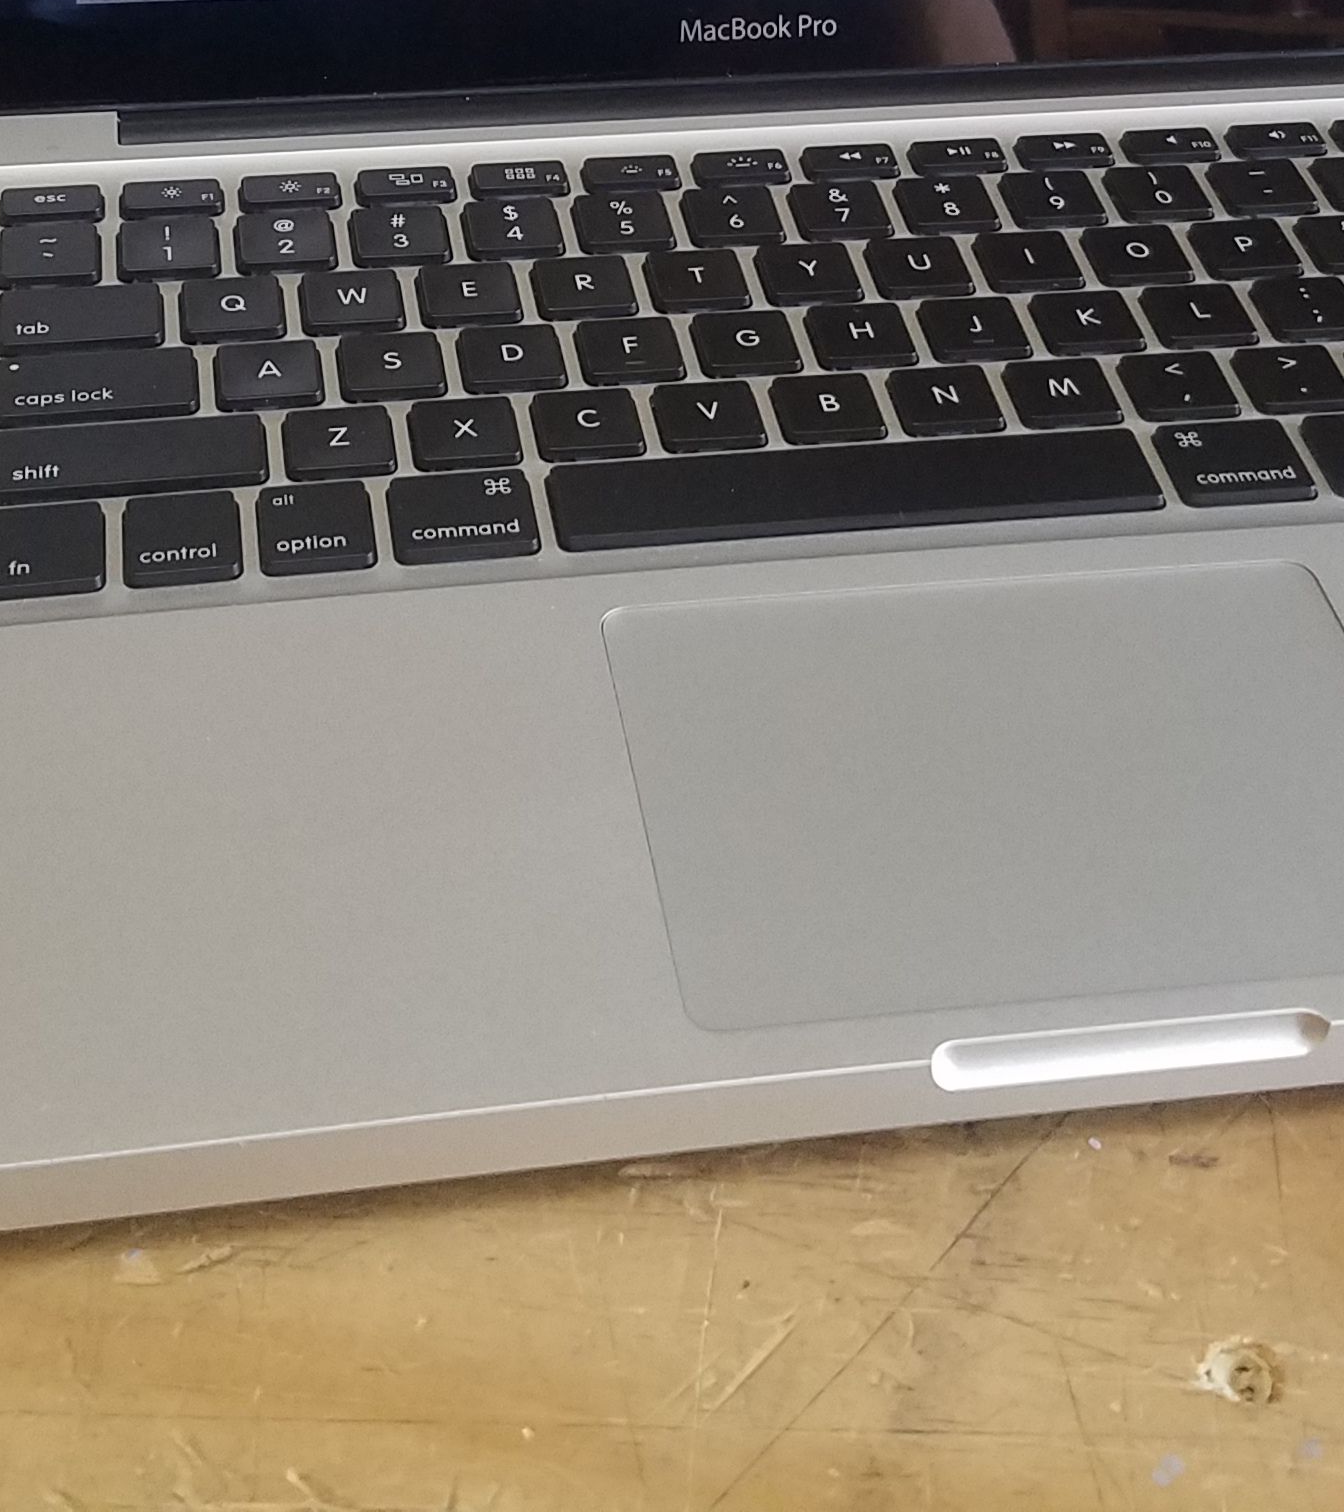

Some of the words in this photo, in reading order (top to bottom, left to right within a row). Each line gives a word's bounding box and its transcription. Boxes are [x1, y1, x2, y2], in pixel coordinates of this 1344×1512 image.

[680, 14, 791, 43] MacBook
[798, 14, 837, 37] Pro
[876, 156, 889, 164] F7
[984, 151, 999, 159] F8
[658, 168, 672, 176] F5
[768, 162, 782, 170] F6
[433, 180, 447, 188] F3
[546, 173, 559, 182] F4
[34, 193, 66, 203] esc
[829, 189, 848, 203] &
[1050, 196, 1064, 210] 9
[503, 204, 518, 222] $
[610, 201, 633, 215] %
[835, 208, 850, 223] 7
[944, 201, 960, 216] 8
[274, 218, 294, 233] @
[391, 214, 405, 228] #
[620, 221, 634, 235] 5
[730, 214, 744, 229] 6
[394, 234, 409, 247] 3
[507, 226, 523, 240] 4
[278, 240, 294, 253] 2
[1126, 243, 1149, 259] O
[1234, 236, 1252, 252] P
[164, 247, 173, 261] 1
[908, 253, 931, 270] U
[688, 266, 705, 283] T
[799, 260, 818, 276] Y
[462, 282, 477, 297] E
[575, 274, 594, 291] R
[221, 294, 247, 312] Q
[338, 287, 367, 304] W
[1076, 308, 1101, 326] K
[1190, 301, 1211, 319] L
[16, 321, 49, 334] tab
[849, 321, 874, 339] H
[970, 315, 982, 332] J
[622, 336, 638, 353] F
[736, 329, 760, 346] G
[384, 352, 401, 370] S
[502, 344, 523, 361] D
[258, 361, 281, 378] A
[932, 385, 959, 404] N
[1049, 377, 1080, 397] M
[14, 391, 65, 406] caps
[71, 388, 113, 402] lock
[819, 393, 840, 412] B
[577, 409, 600, 428] C
[696, 401, 719, 420] V
[454, 418, 478, 438] X
[329, 427, 350, 447] Z
[12, 463, 59, 481] shift
[1196, 466, 1296, 484] command
[272, 493, 294, 506] alt
[412, 519, 520, 541] command
[276, 534, 347, 553] option
[139, 543, 217, 563] control
[9, 559, 30, 575] fn
